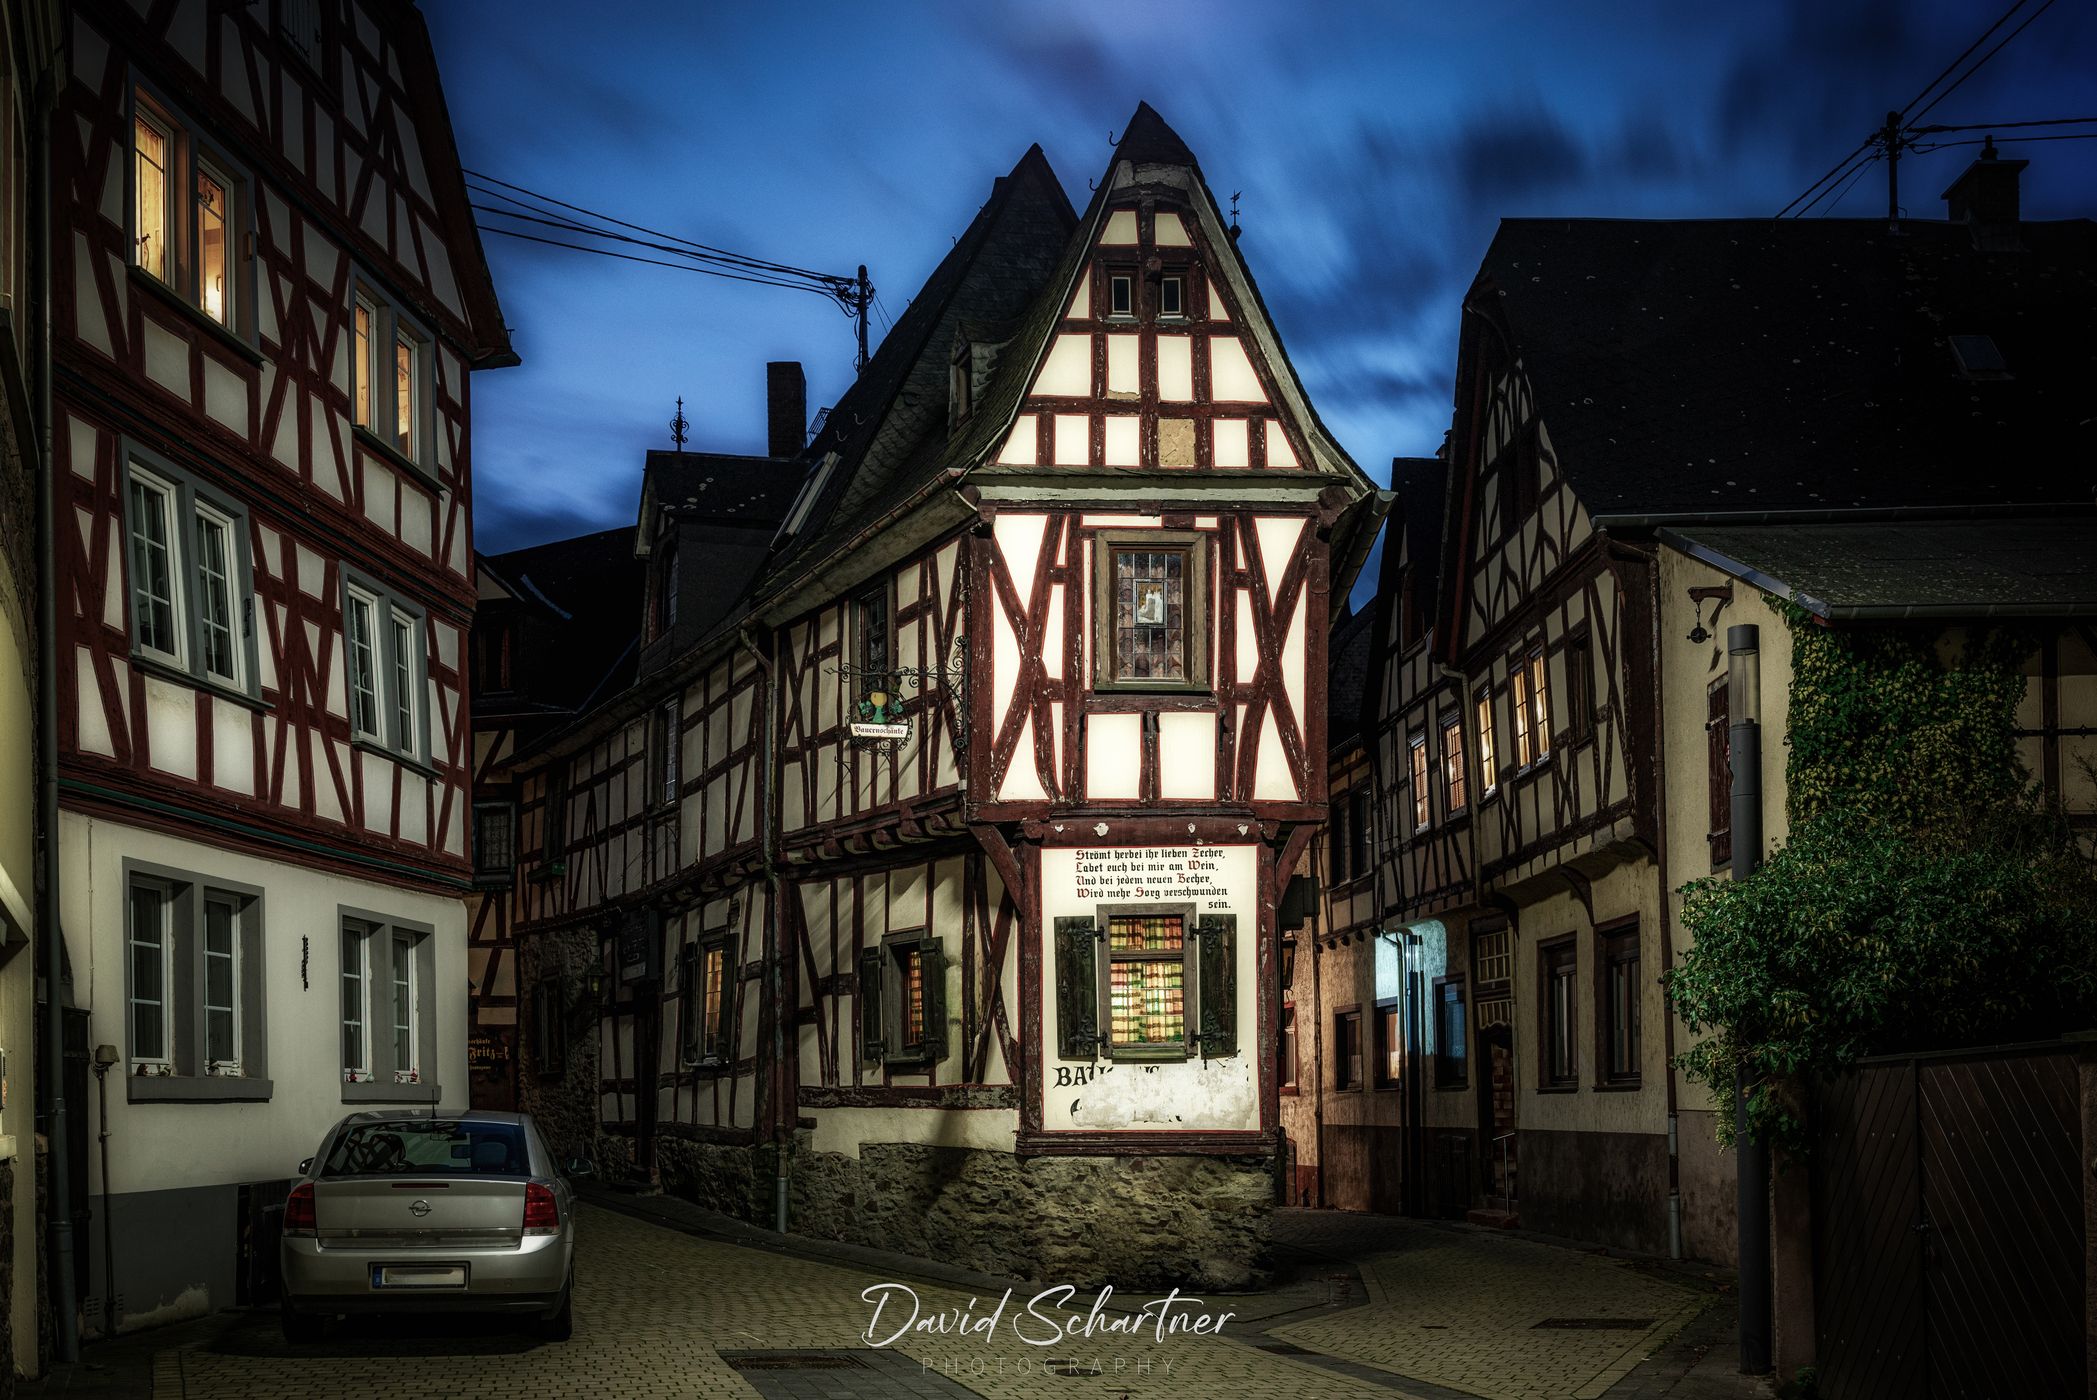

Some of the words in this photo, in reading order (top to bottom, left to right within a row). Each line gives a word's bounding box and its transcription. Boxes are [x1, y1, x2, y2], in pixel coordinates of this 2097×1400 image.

[1075, 849, 1111, 860] Strömt
[1114, 849, 1142, 860] herbei
[1145, 849, 1159, 860] ihr
[1161, 849, 1188, 858] lieben
[1192, 848, 1226, 860] Zecher,
[1076, 861, 1103, 873] Labet
[1107, 862, 1128, 874] euch
[1130, 862, 1144, 872] bei
[1148, 862, 1165, 871] mir
[1169, 863, 1183, 871] am
[1188, 860, 1219, 872] Wein,
[1076, 875, 1096, 885] Und
[1099, 875, 1113, 885] bei
[1116, 875, 1144, 886] jedem
[1146, 876, 1173, 884] neuen
[1177, 873, 1213, 885] Becher,
[1077, 888, 1104, 898] Wird
[1107, 889, 1131, 900] mehr
[1134, 886, 1161, 899] Sorg
[1163, 885, 1228, 900] verschwunden
[1208, 899, 1231, 909] sein.
